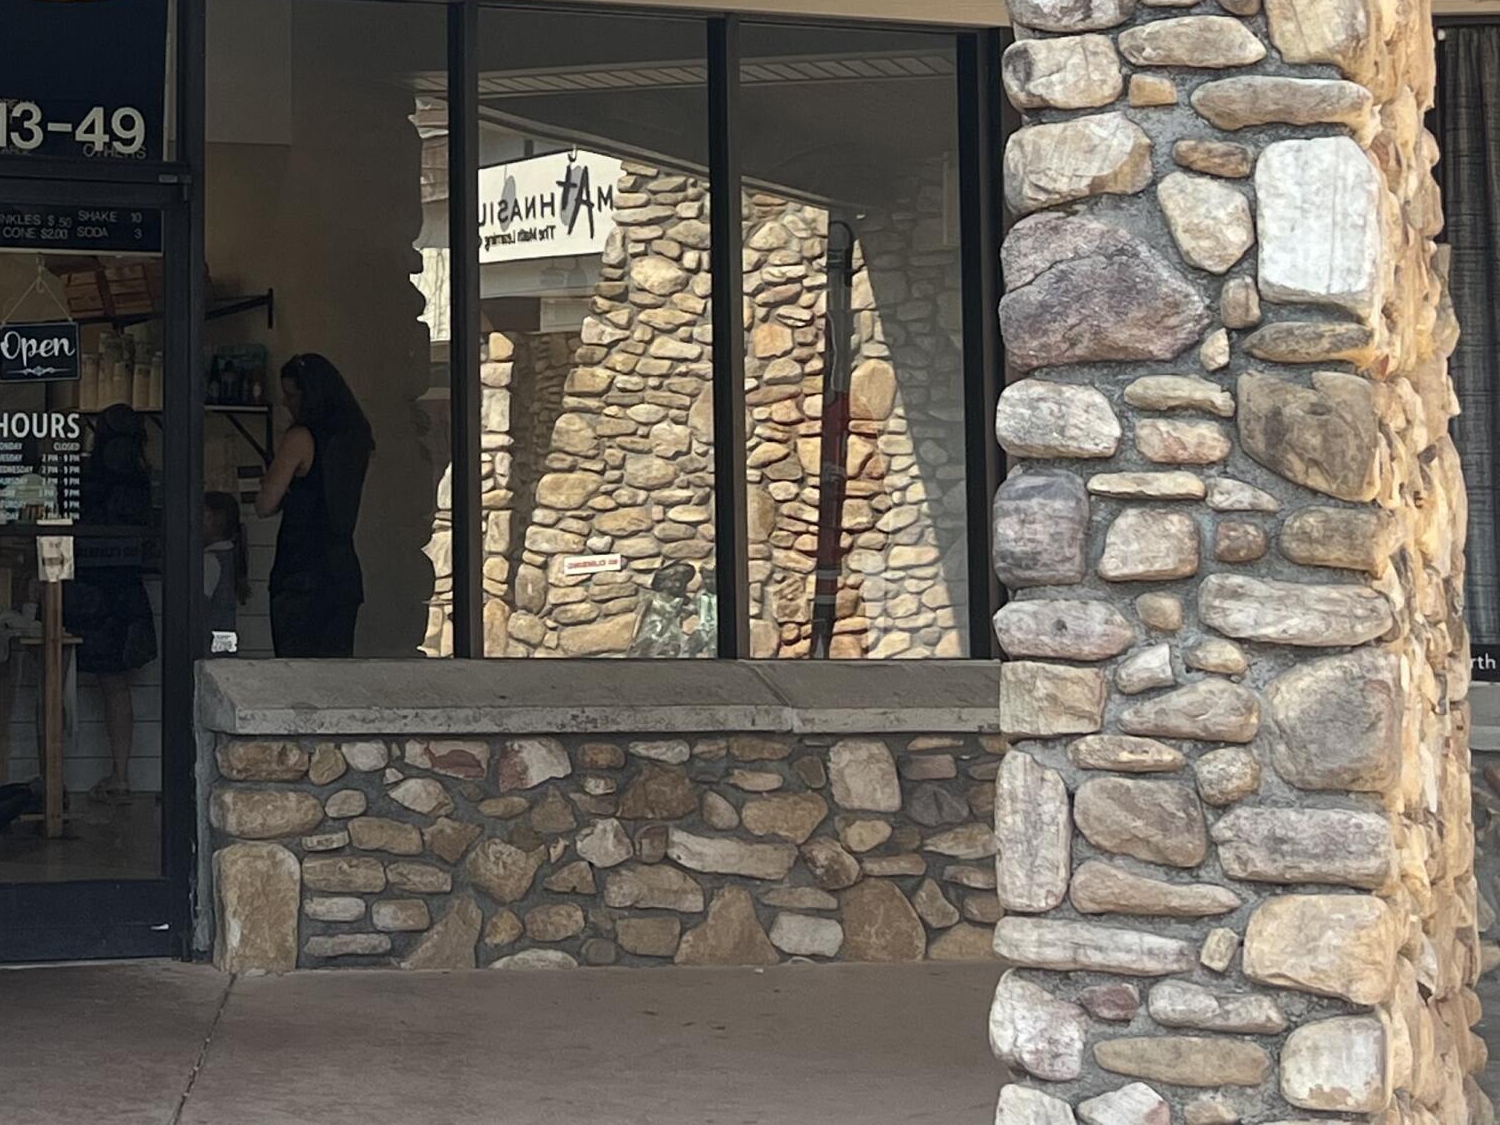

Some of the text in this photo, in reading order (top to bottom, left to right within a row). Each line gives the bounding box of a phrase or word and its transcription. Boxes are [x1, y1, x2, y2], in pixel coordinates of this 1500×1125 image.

[78, 210, 118, 223] SHAKE
[3, 227, 37, 239] CONE
[77, 226, 109, 238] SODA
[0, 330, 76, 367] Open
[53, 442, 80, 451] CLOSED
